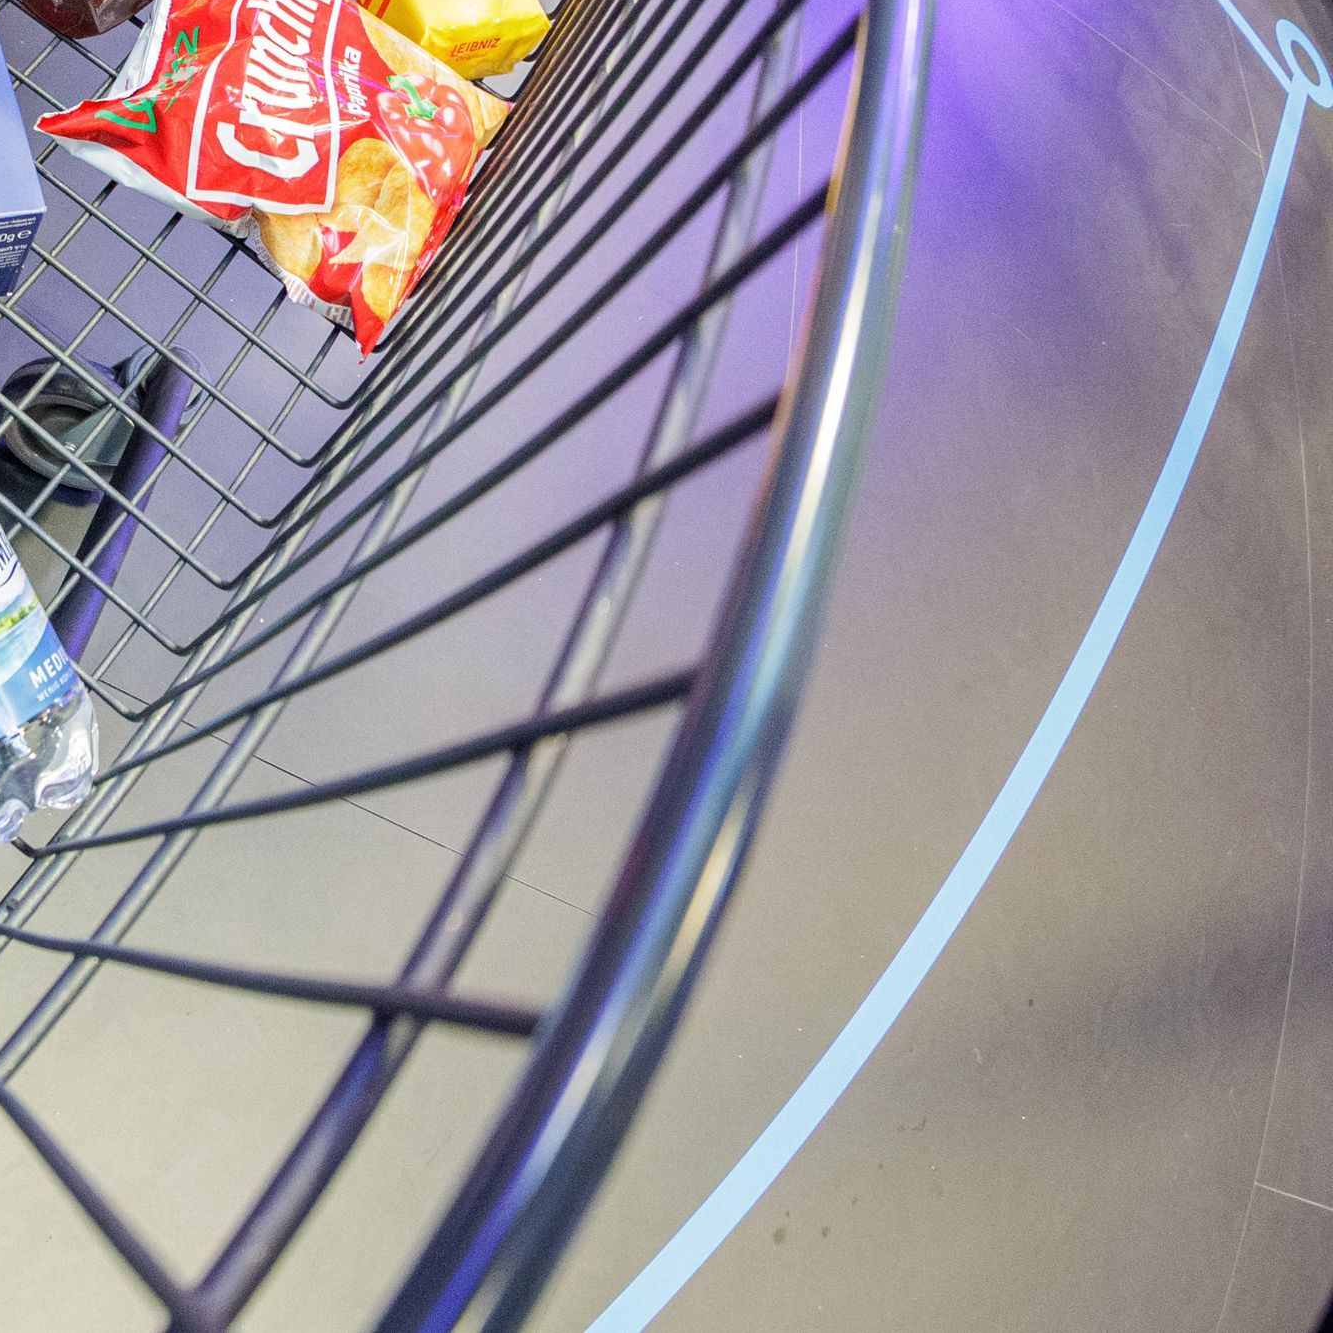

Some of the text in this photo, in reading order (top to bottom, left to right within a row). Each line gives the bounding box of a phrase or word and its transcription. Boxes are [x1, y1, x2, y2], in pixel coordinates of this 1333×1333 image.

[450, 37, 502, 58] LEIBNIZ
[347, 45, 373, 117] Paprika
[27, 648, 70, 689] MEDI
